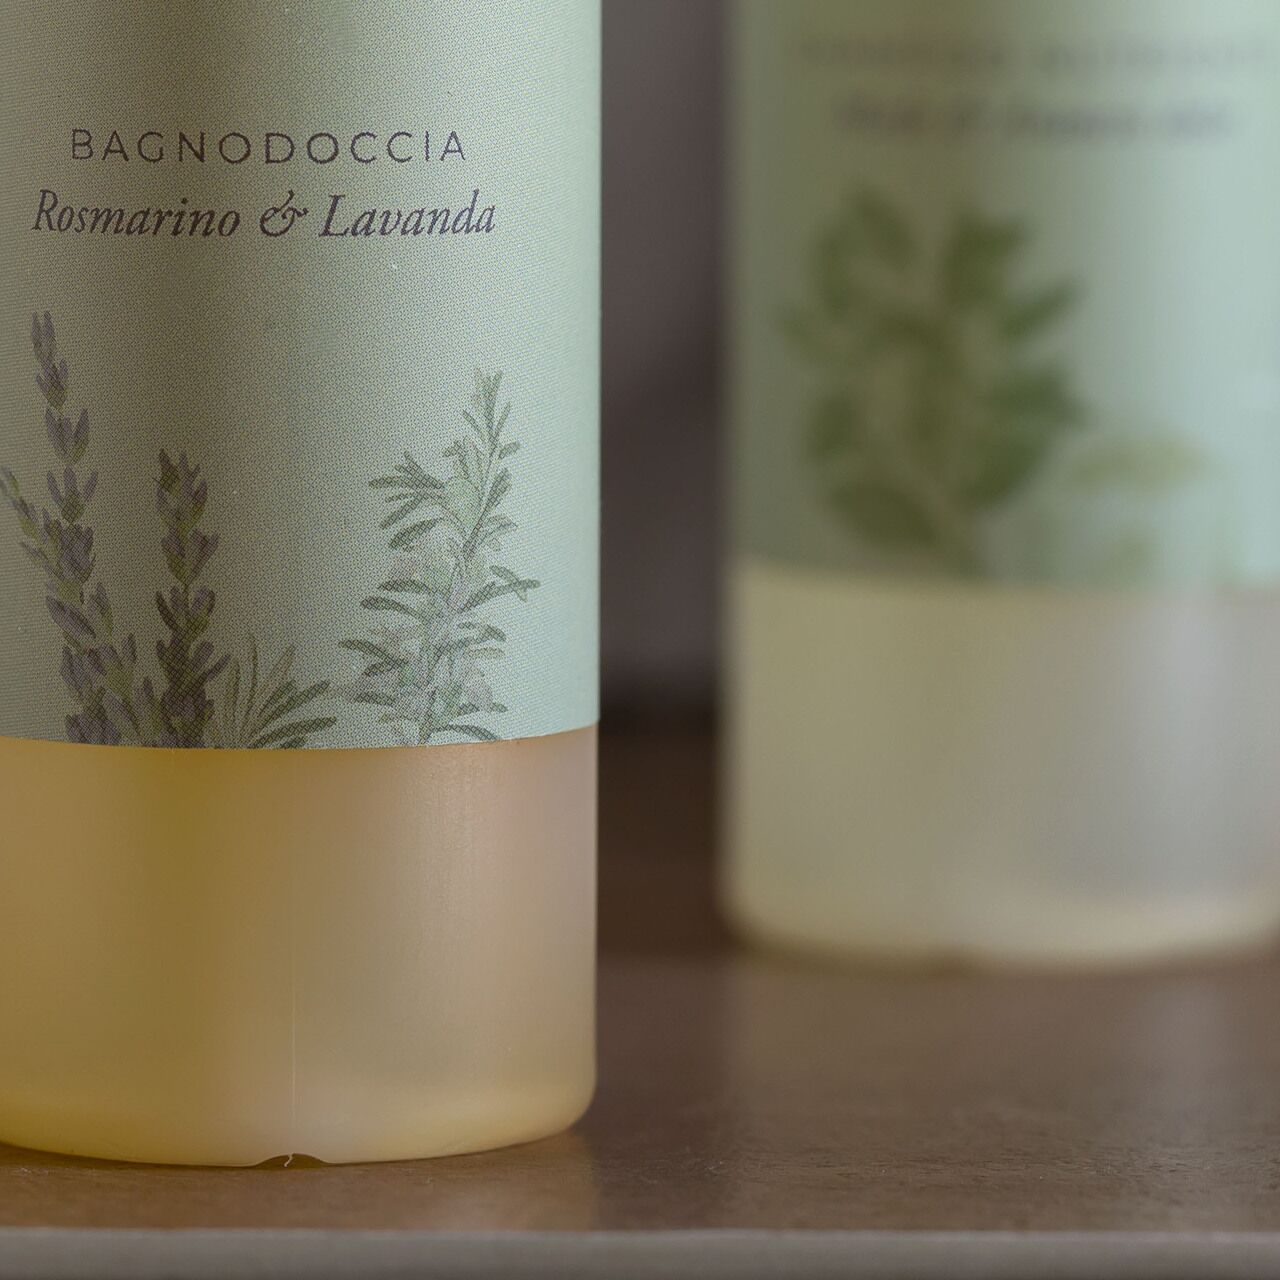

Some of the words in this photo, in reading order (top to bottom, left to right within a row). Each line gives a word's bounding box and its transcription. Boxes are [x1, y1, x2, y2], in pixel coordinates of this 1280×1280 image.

[70, 128, 467, 165] BAGNODOCCIA
[32, 188, 241, 238] Rosmarino
[258, 189, 310, 238] &
[318, 188, 497, 238] Lavanda
